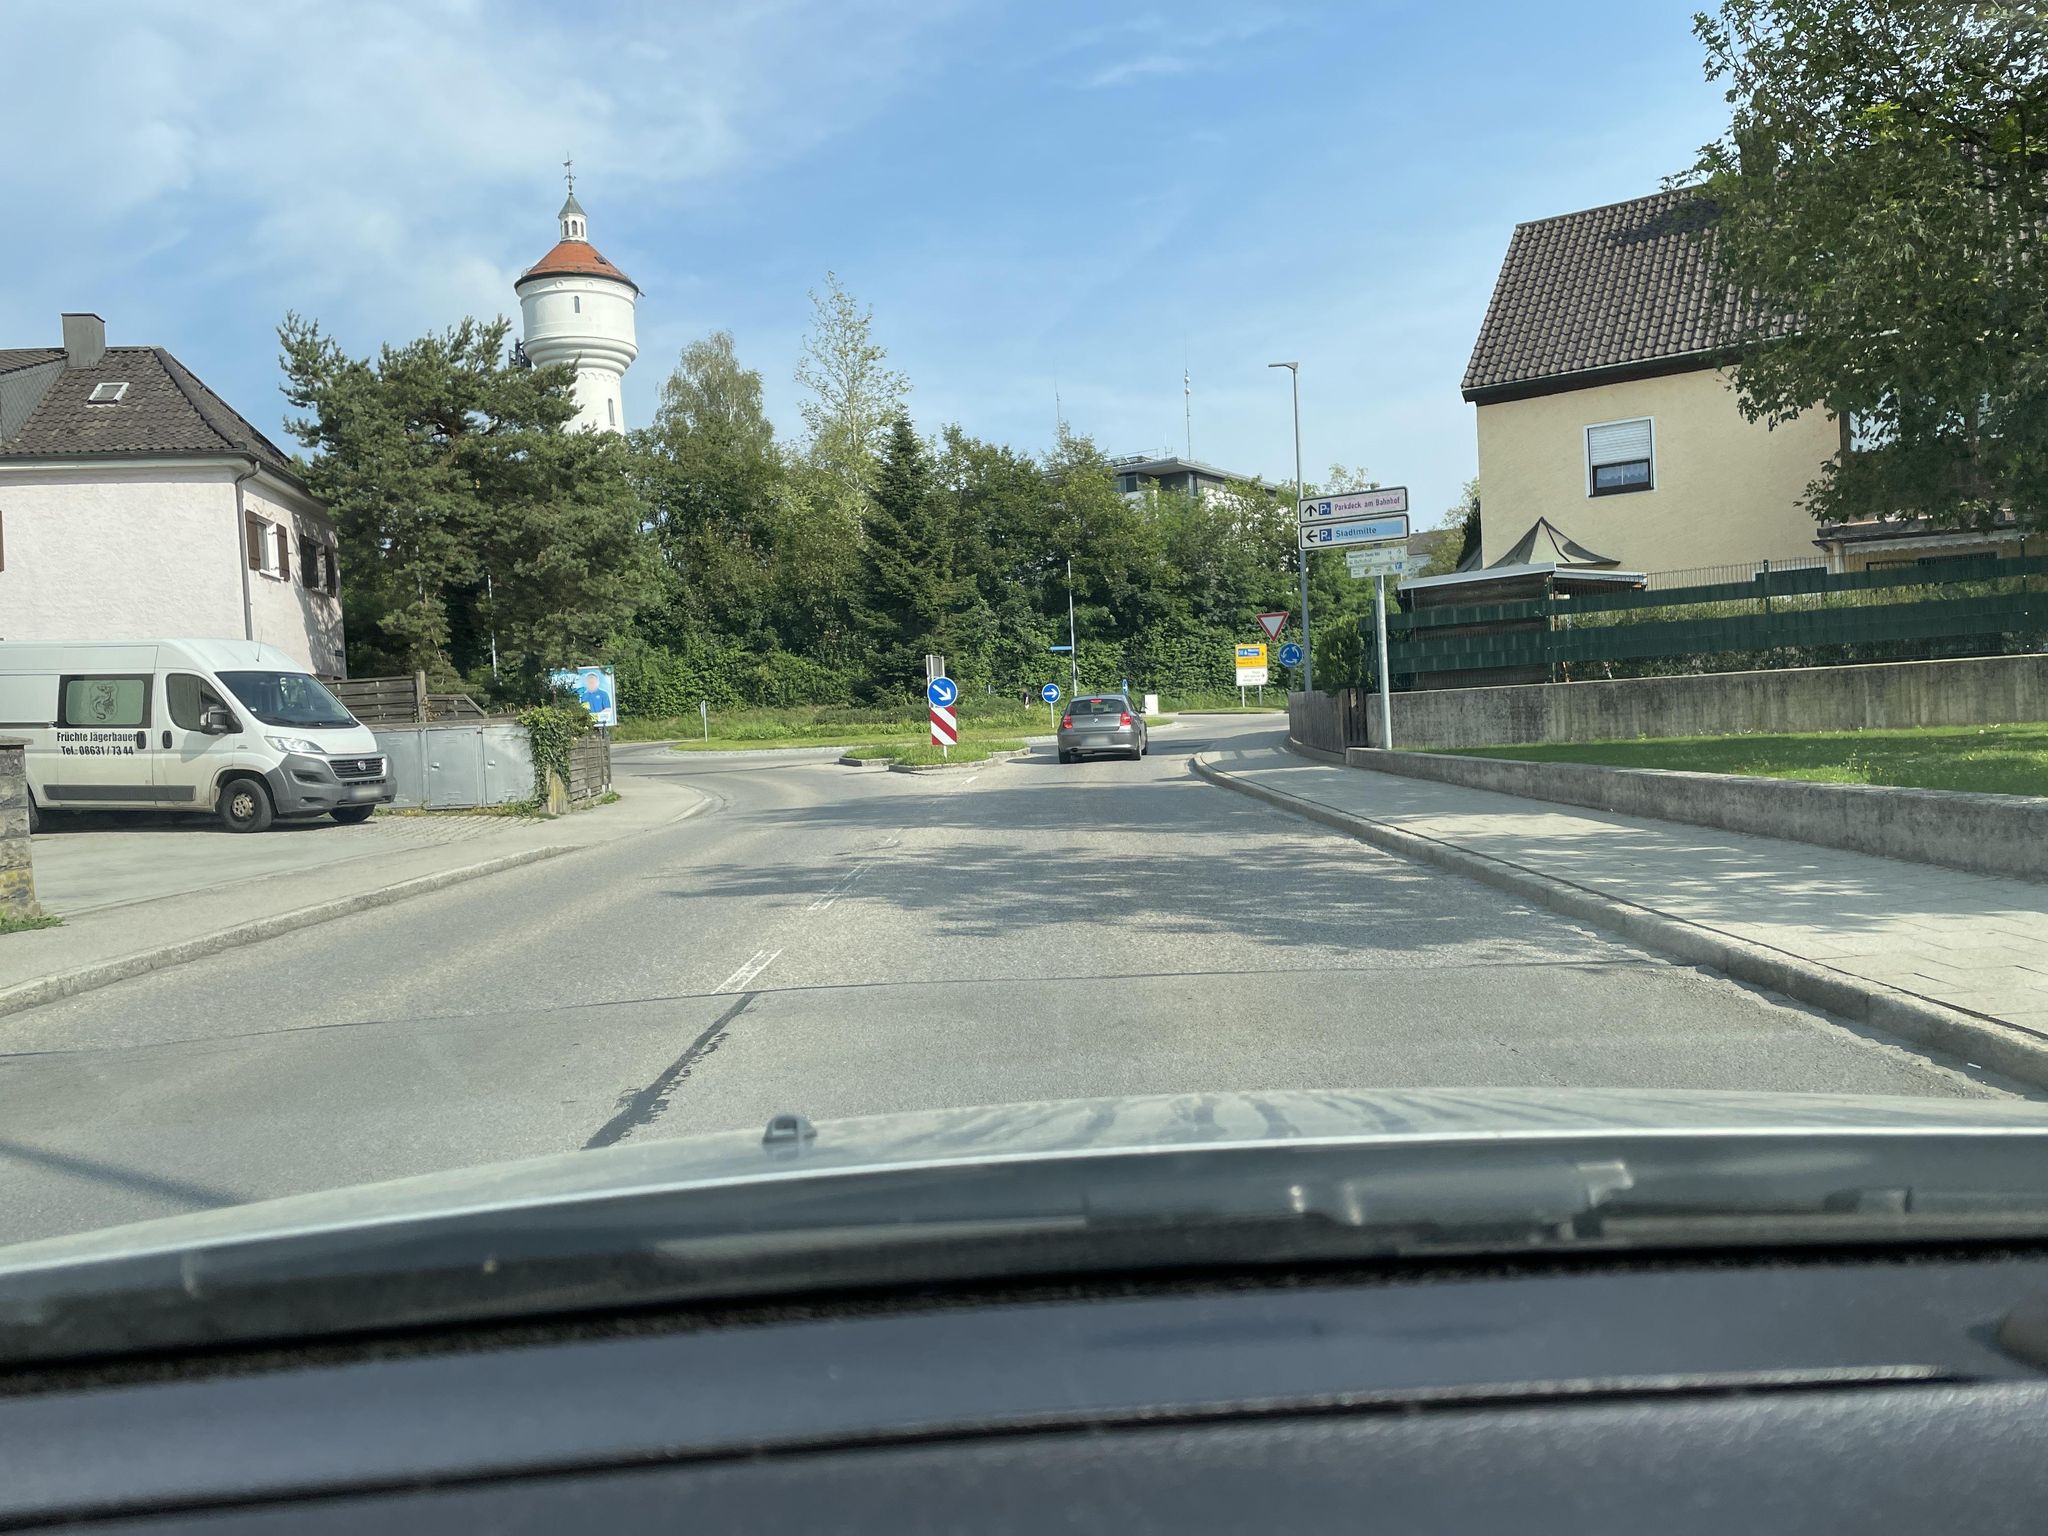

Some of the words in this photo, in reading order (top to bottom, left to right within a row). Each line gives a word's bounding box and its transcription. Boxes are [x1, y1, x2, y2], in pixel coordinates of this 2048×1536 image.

[1335, 501, 1362, 511] Parkdeck
[1375, 496, 1400, 506] Bahnhof
[1336, 527, 1377, 538] Stadtmitte
[57, 731, 88, 742] Früchte
[90, 731, 137, 743] Jägerbauer
[79, 745, 105, 756] 08631
[111, 745, 122, 756] 73
[123, 745, 134, 756] 44
